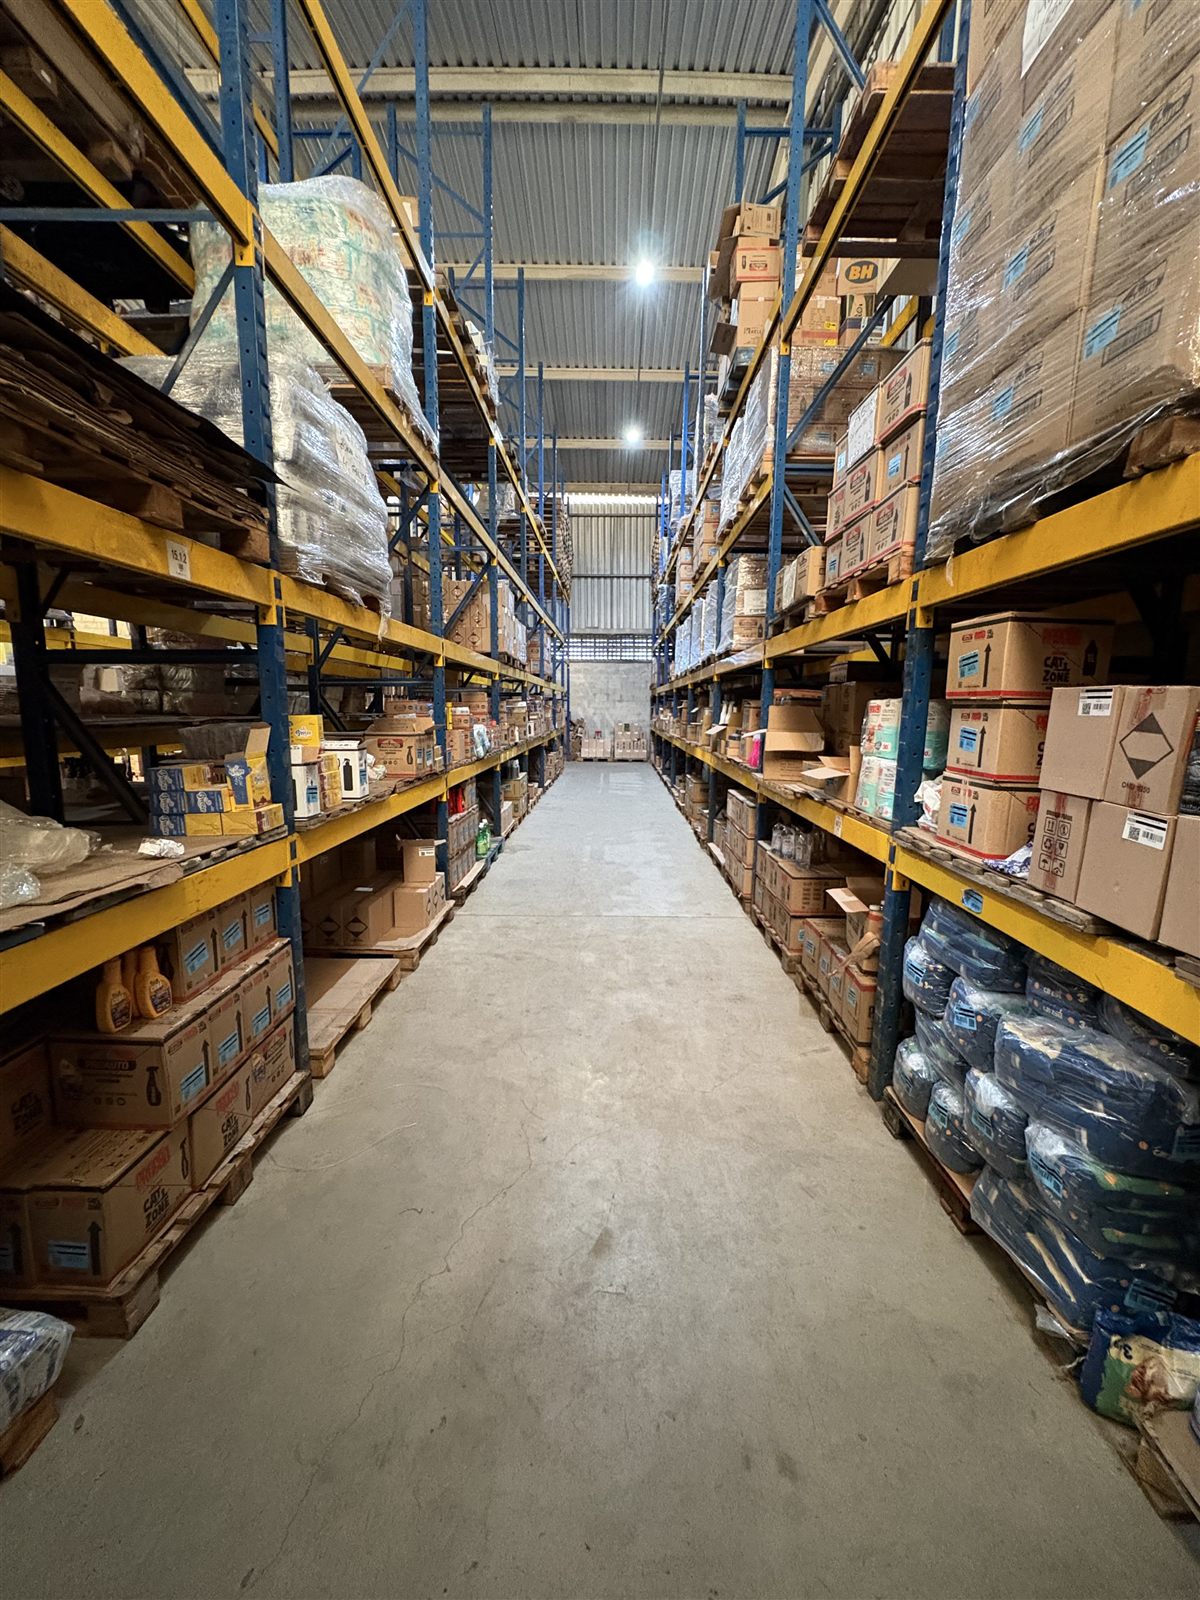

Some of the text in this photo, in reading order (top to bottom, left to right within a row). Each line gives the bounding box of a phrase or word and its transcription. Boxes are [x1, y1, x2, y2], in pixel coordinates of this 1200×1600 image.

[849, 264, 875, 280] BH
[1043, 655, 1066, 669] CAT
[1042, 669, 1070, 682] ZONE
[143, 1186, 166, 1213] CAT
[145, 1200, 170, 1228] ZONE
